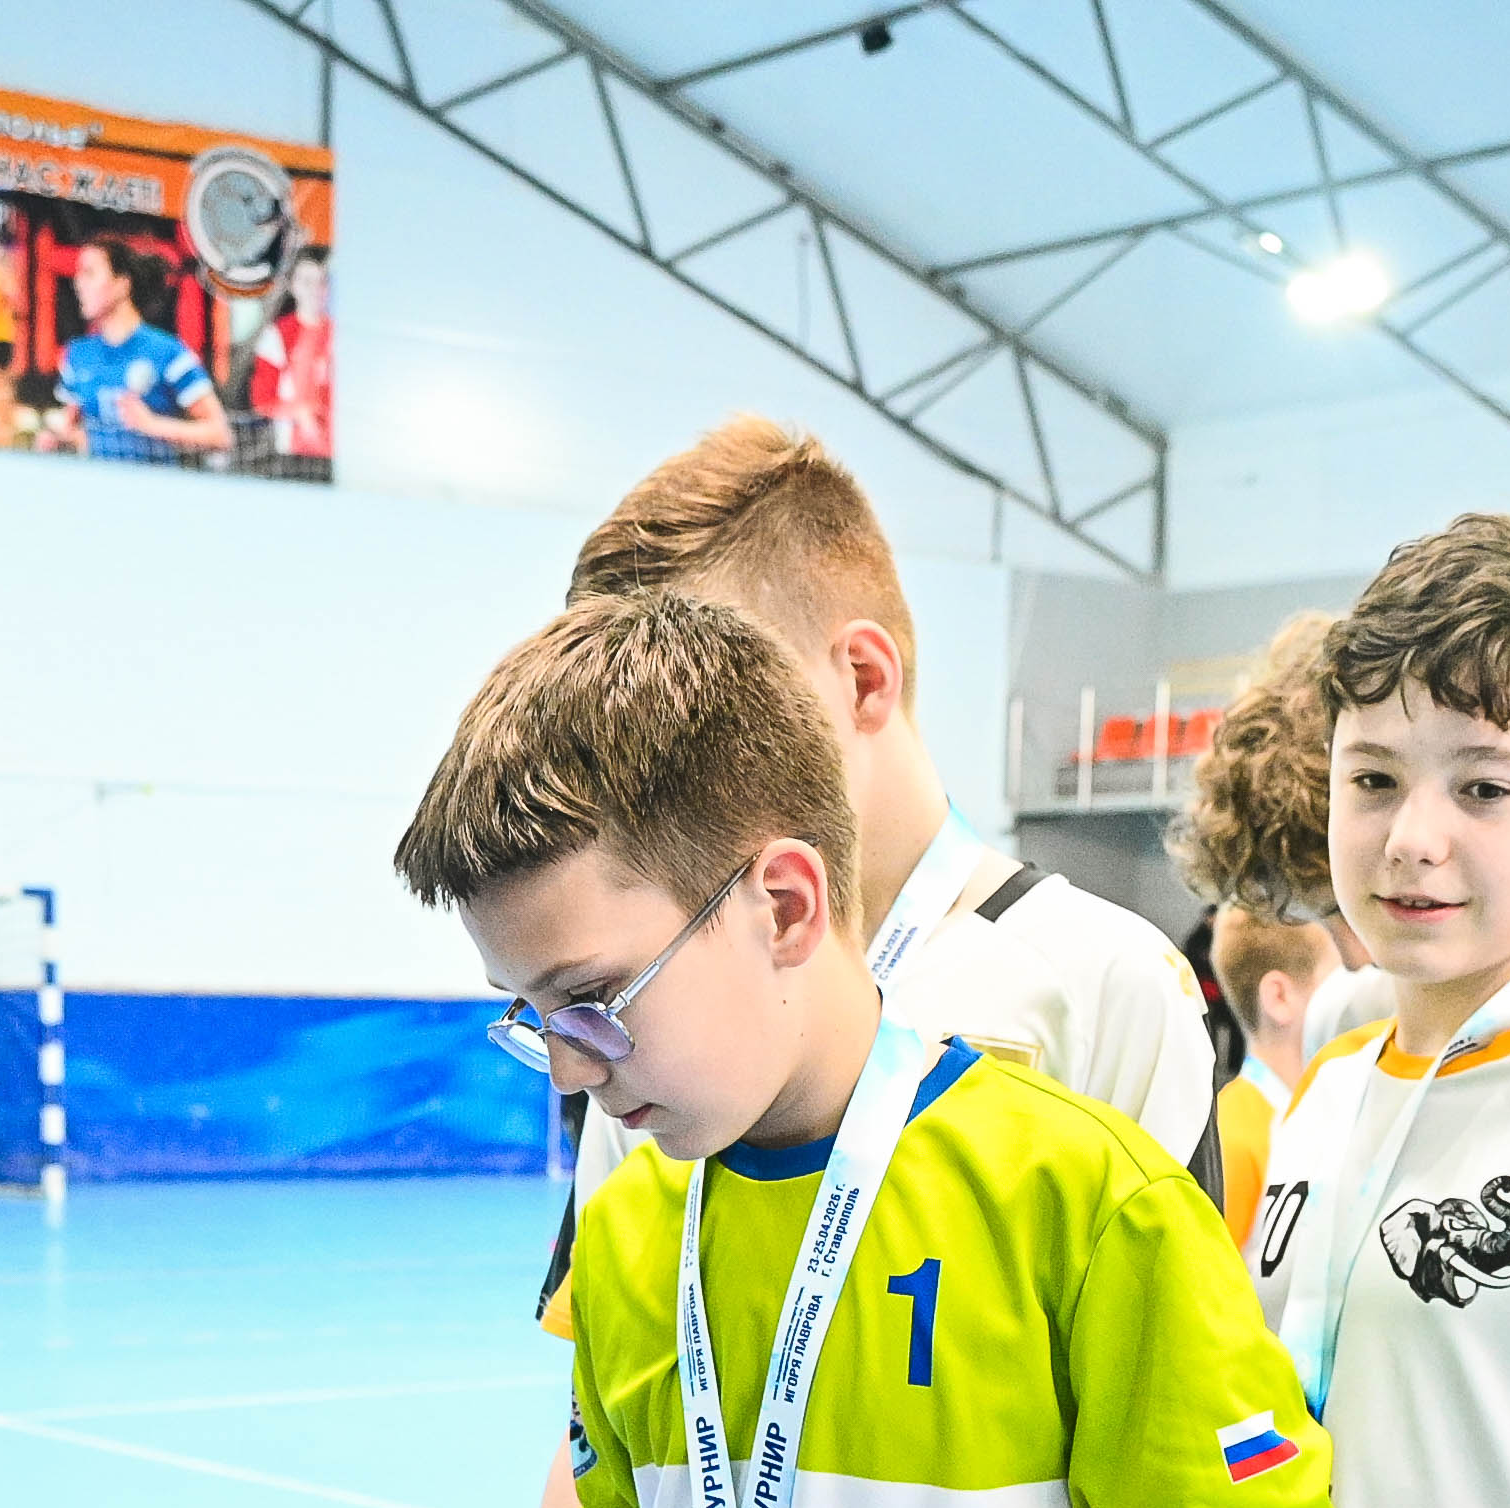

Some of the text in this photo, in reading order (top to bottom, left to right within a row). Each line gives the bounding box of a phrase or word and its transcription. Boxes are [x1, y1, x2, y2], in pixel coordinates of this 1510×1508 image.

[824, 1187, 859, 1264] Ставрополь
[689, 1283, 702, 1344] ЛАВРОВА
[784, 1359, 802, 1403] ИГОРЯ
[794, 1295, 823, 1357] ЛАВРОВА
[887, 1258, 941, 1387] 1
[696, 1348, 708, 1392] ИГОРЯ
